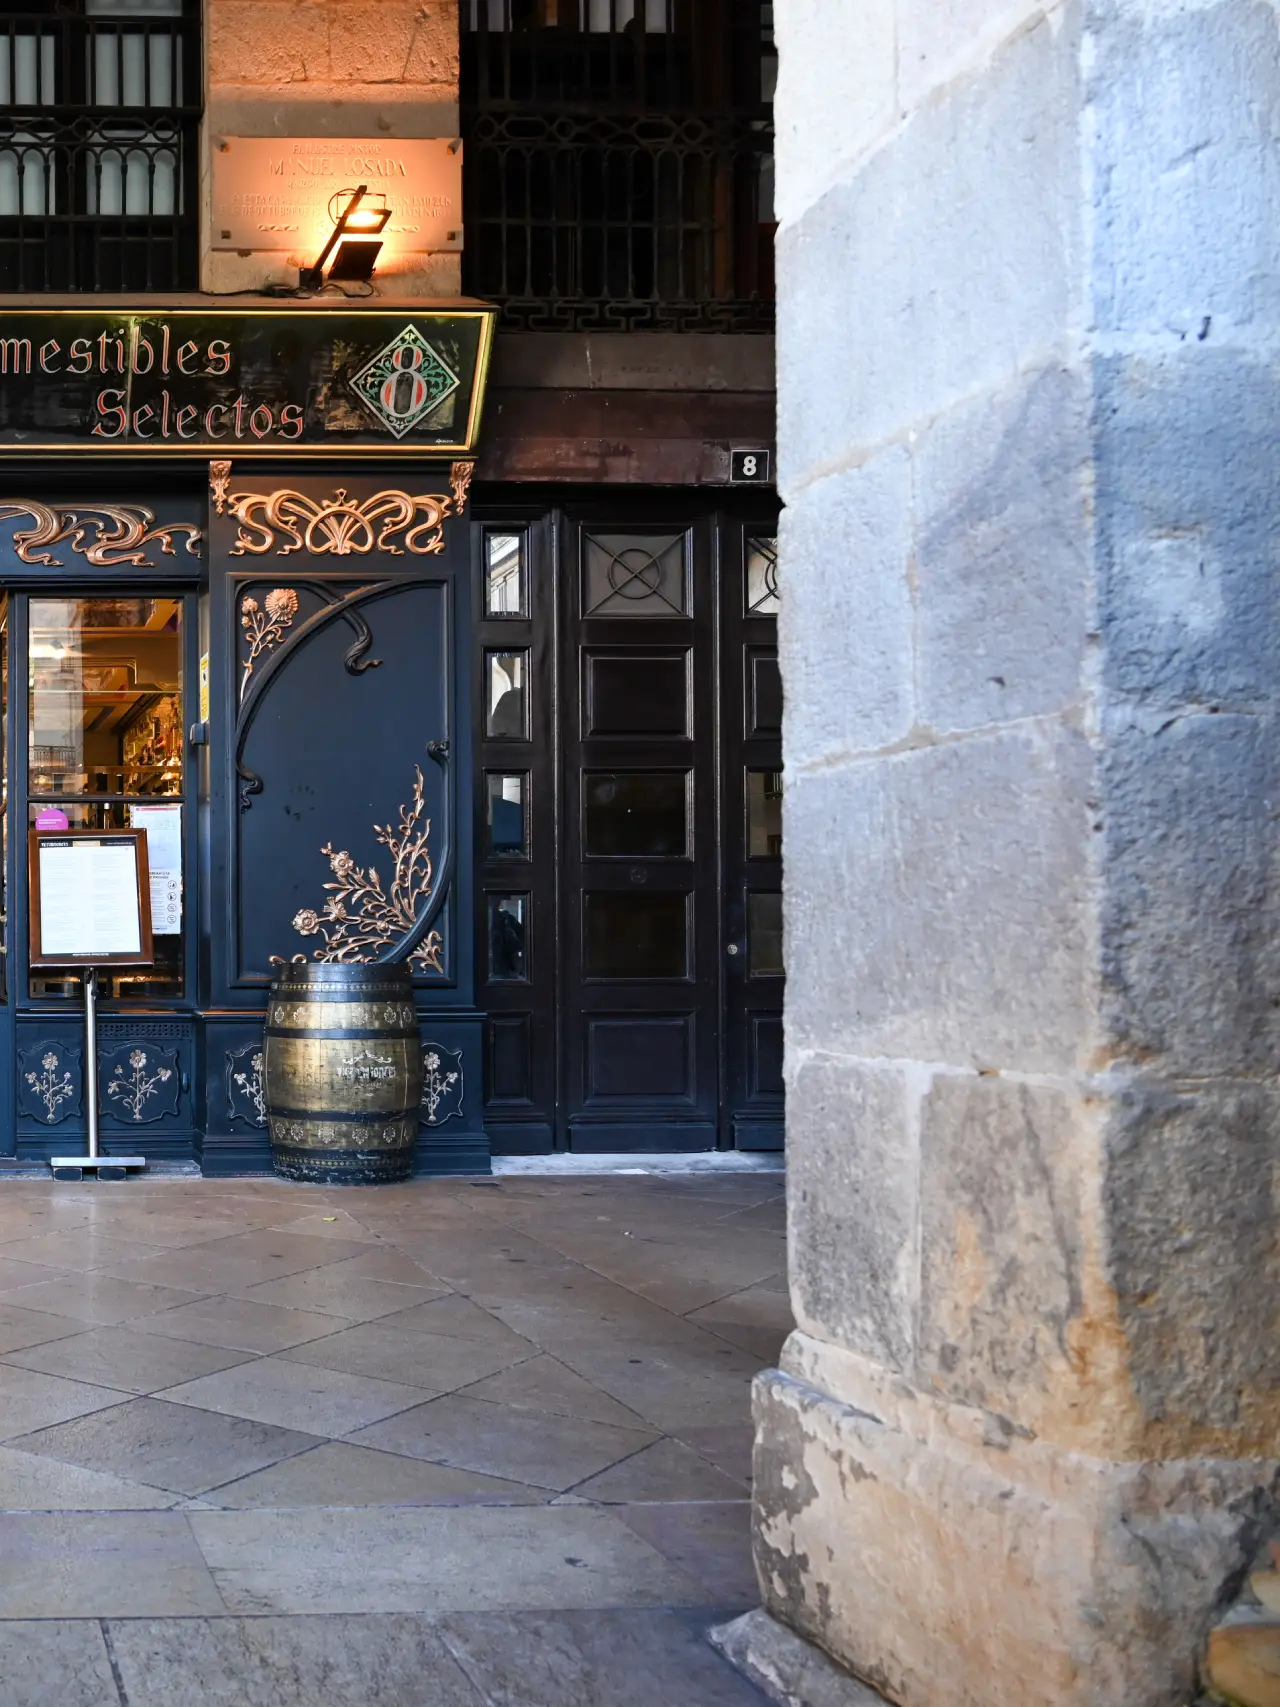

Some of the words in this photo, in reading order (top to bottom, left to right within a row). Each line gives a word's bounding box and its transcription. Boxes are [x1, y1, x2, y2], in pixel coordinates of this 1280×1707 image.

[269, 157, 335, 176] MANUEL
[344, 157, 407, 177] LOSADA
[380, 344, 424, 418] 8
[91, 388, 304, 439] Selectos
[742, 455, 757, 476] 8
